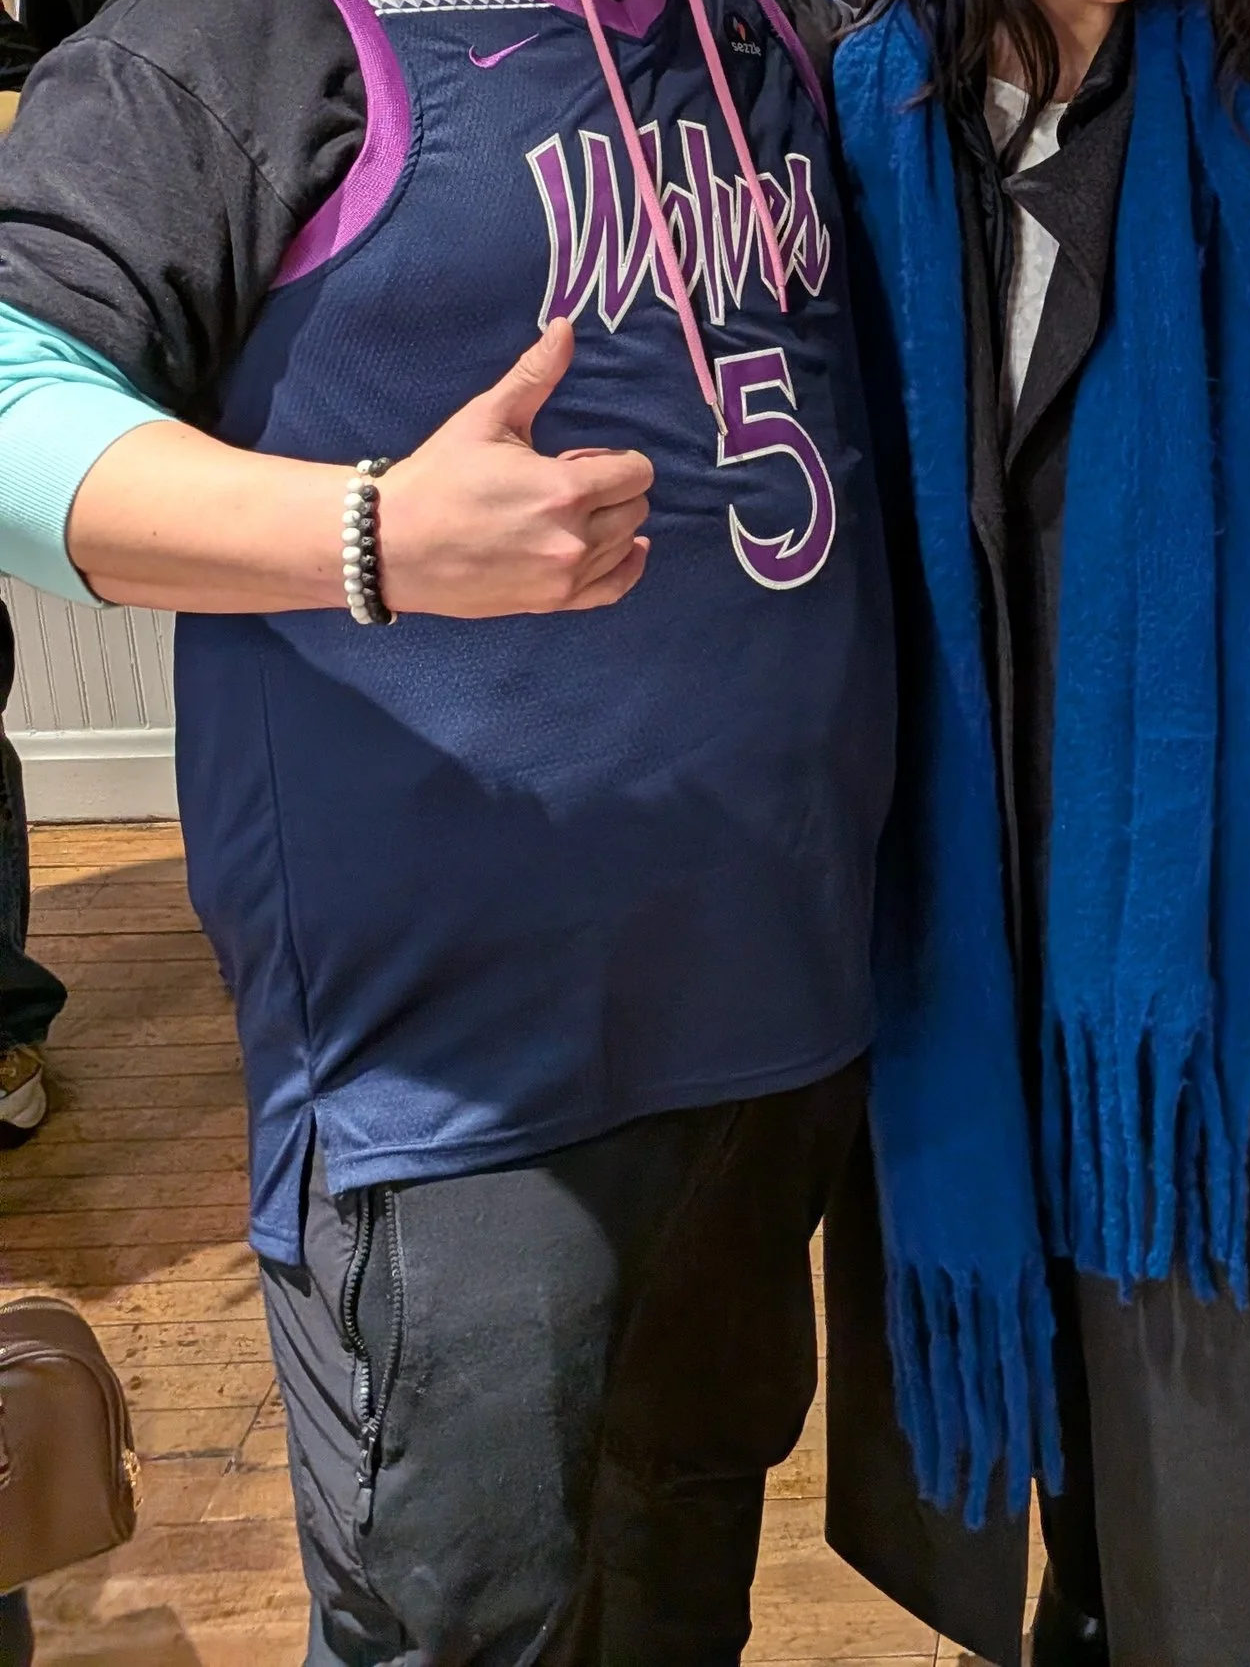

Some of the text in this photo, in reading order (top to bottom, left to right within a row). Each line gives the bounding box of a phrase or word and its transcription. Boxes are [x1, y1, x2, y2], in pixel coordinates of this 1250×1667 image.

[731, 41, 762, 57] sezzle
[526, 119, 830, 334] Wolves
[715, 347, 837, 590] 5
